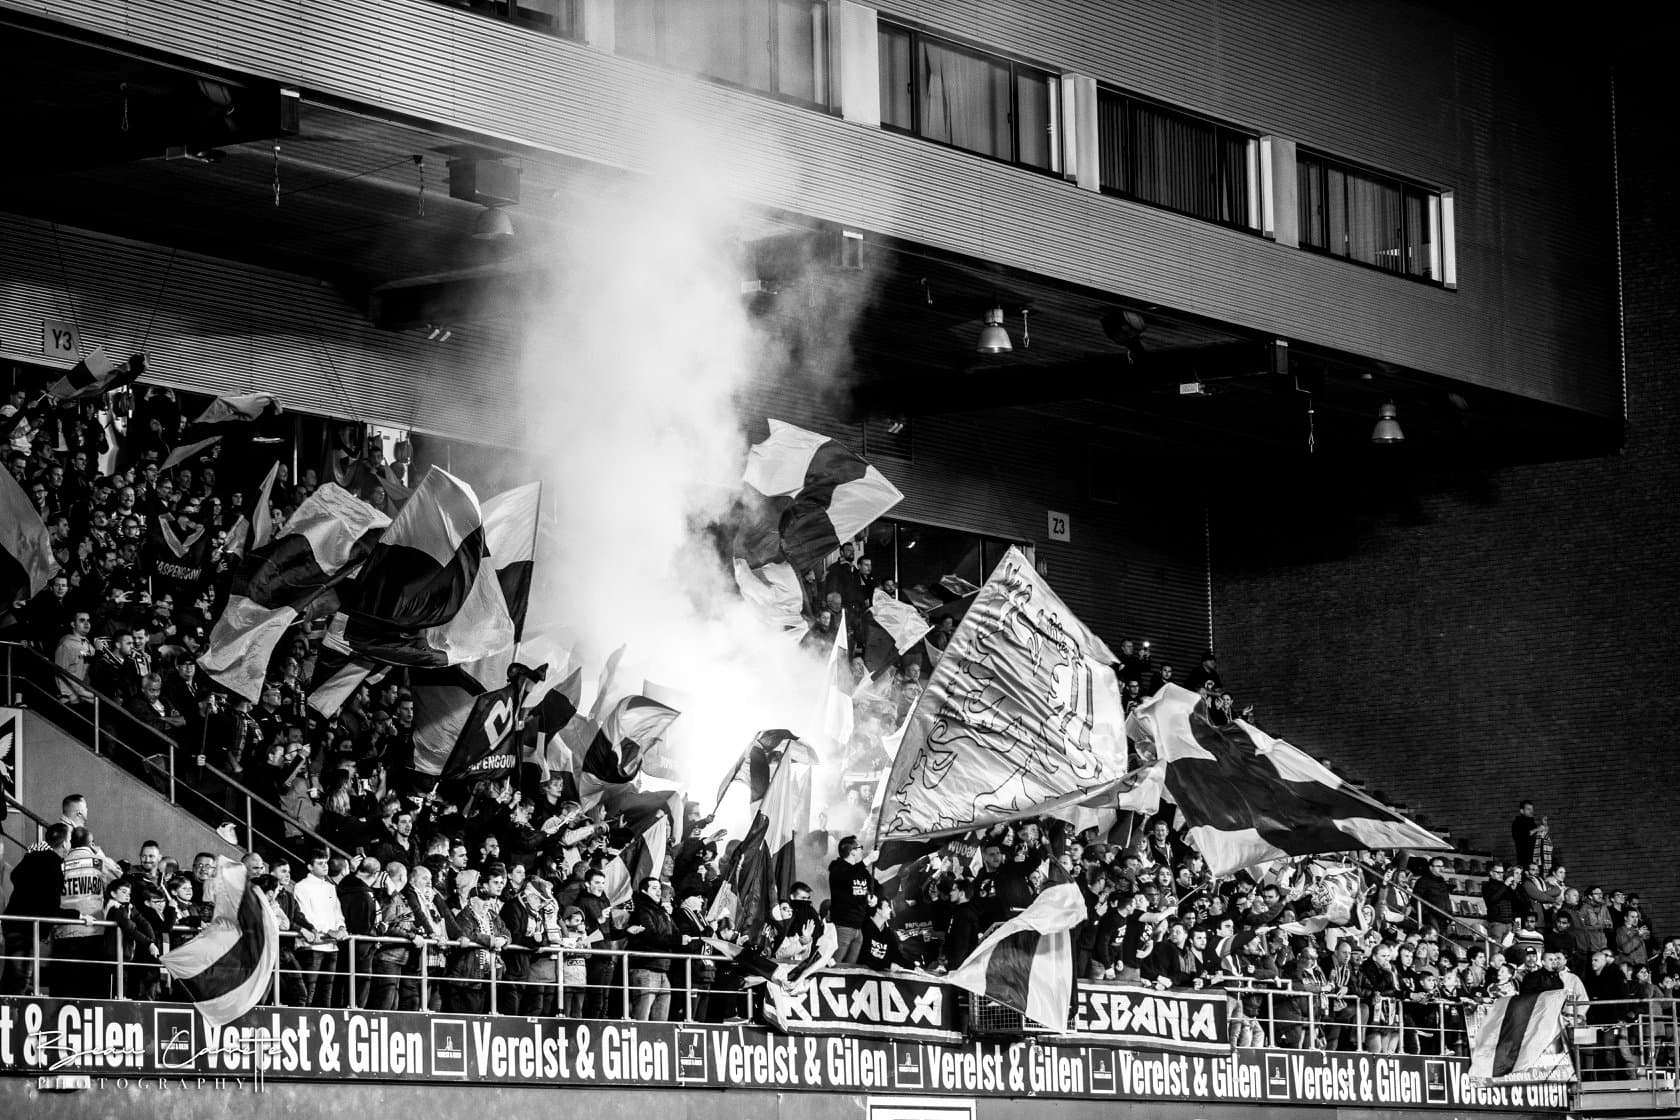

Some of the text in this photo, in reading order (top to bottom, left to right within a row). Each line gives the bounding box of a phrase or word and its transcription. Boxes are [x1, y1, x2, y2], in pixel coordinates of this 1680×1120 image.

[52, 329, 72, 351] Y3
[1053, 518, 1065, 535] Z3
[784, 976, 943, 1026] RIGADA
[1076, 992, 1218, 1041] ESBANIA
[23, 1003, 48, 1066] &
[58, 1004, 144, 1067] Gilen
[202, 1012, 424, 1074] Verelst & Gilen
[473, 1021, 669, 1081] Verelst & Gilen
[712, 1030, 888, 1087] Verelst & Gilen
[926, 1041, 1085, 1093] Verelst & Gilen
[1118, 1049, 1262, 1098] Verelst & Gilen
[1291, 1054, 1422, 1103] Verelst & Gilen
